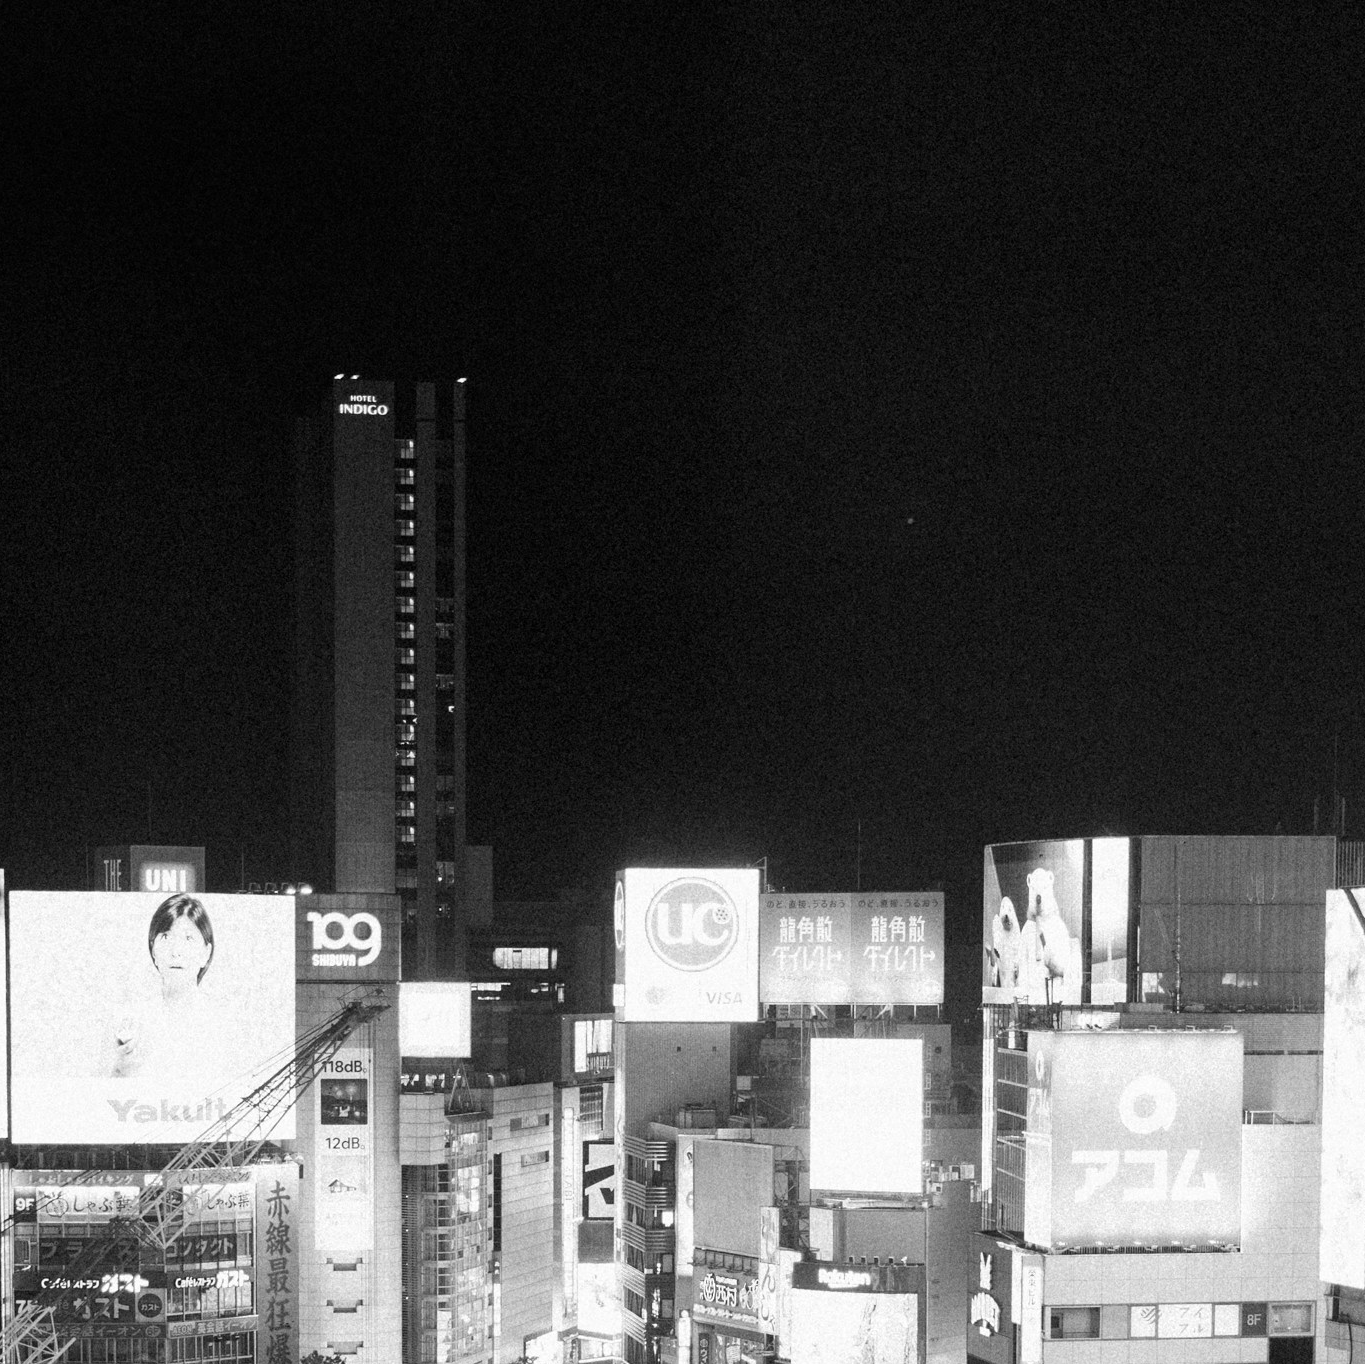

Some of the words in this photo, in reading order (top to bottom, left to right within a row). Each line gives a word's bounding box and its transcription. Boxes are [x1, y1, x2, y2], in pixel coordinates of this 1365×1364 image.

[350, 395, 377, 403] HOTEL
[339, 404, 389, 416] INDIGO
[104, 860, 121, 891] THE
[779, 916, 833, 943] 龍角散
[871, 915, 926, 943] 龍角散
[307, 911, 382, 967] 109
[312, 954, 356, 967] SHIBUYA
[706, 991, 742, 1004] VISA
[106, 1098, 228, 1123] Yakult
[1072, 1150, 1220, 1203] アコム
[15, 1198, 34, 1211] 9F
[216, 1269, 250, 1289] ガスト
[141, 1303, 160, 1312] ガスト
[1247, 1314, 1261, 1326] 8F
